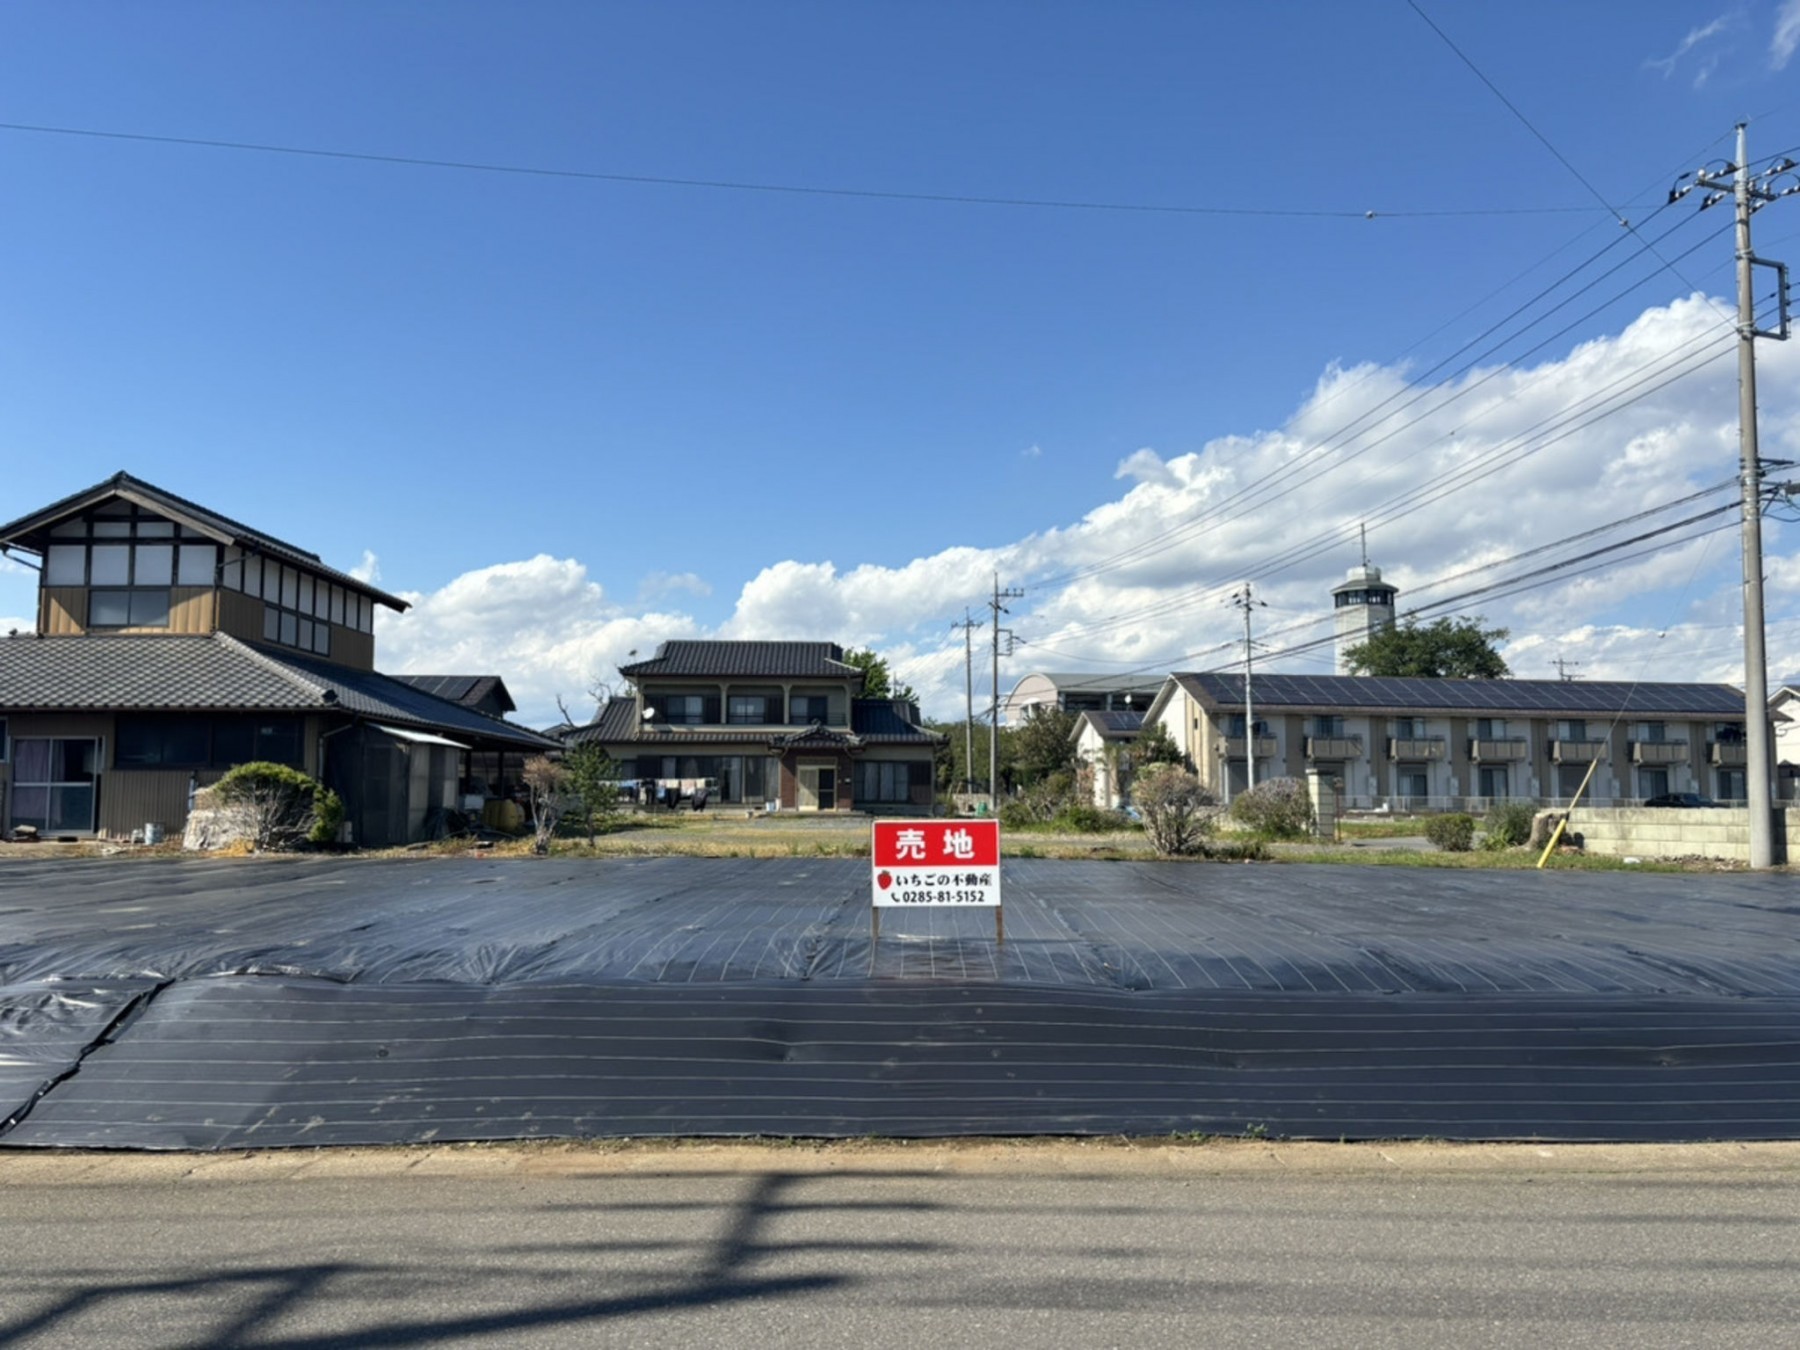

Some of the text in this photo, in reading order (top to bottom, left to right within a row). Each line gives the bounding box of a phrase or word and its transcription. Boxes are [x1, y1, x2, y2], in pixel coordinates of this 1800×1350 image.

[896, 828, 975, 860] 売地
[896, 873, 992, 886] いちごの不動産
[902, 890, 985, 903] 0285-81-5152
